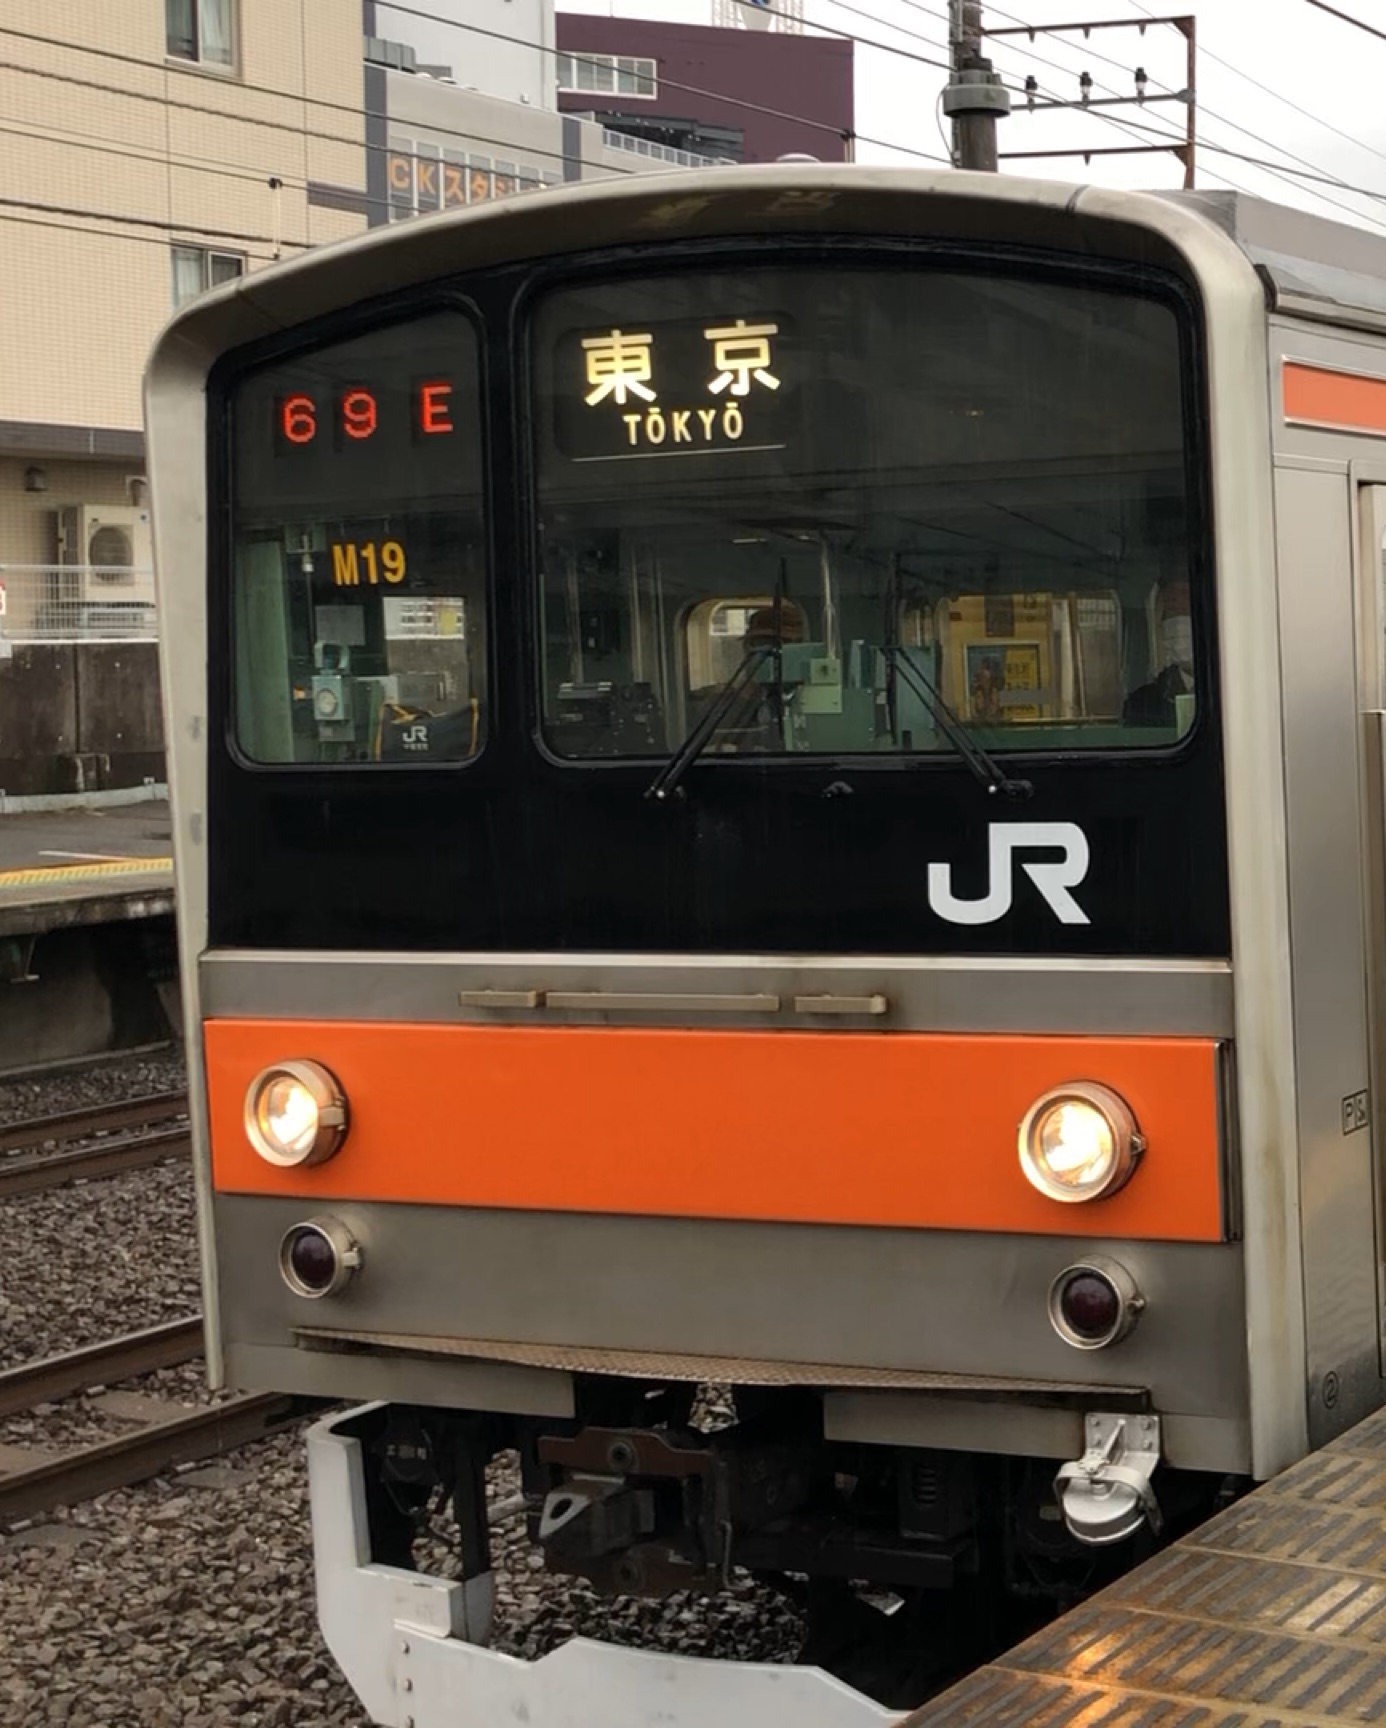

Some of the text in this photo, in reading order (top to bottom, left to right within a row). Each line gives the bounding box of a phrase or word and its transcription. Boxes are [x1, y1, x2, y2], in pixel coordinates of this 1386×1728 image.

[581, 319, 781, 406] 東京
[622, 401, 743, 446] TŌKYŌ
[331, 541, 406, 587] M19
[402, 725, 428, 742] JR
[927, 822, 1091, 925] JR
